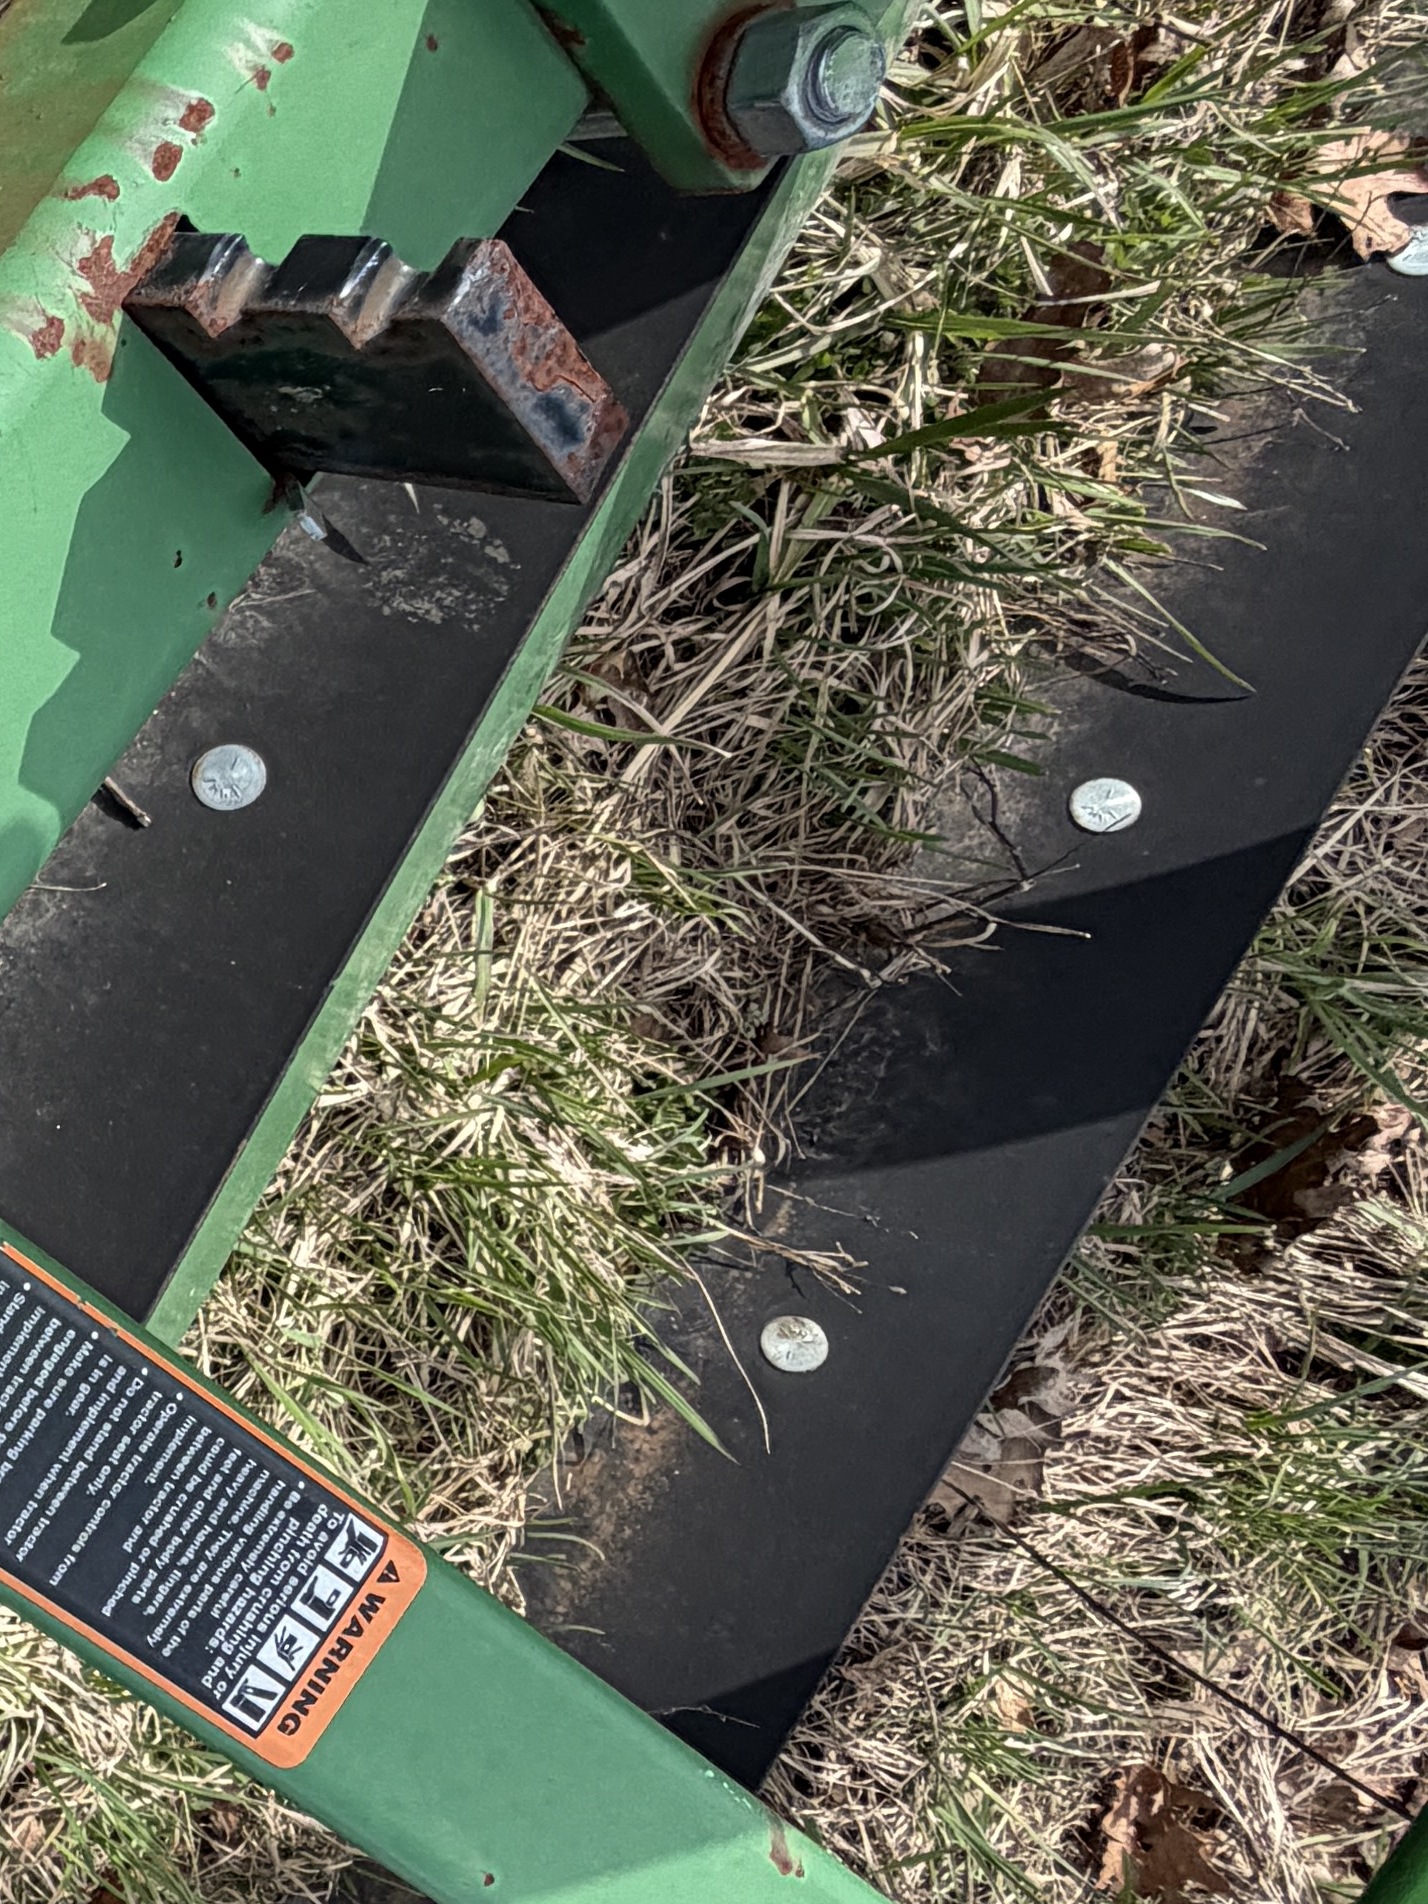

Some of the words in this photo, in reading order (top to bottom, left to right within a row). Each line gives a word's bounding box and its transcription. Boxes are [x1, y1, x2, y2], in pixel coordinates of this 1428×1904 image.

[18, 1317, 63, 1375] between
[33, 1329, 76, 1389] engaged
[63, 1340, 94, 1377] Make
[98, 1354, 114, 1368] is
[43, 1377, 68, 1409] sure
[87, 1368, 104, 1384] in
[105, 1365, 127, 1394] and
[125, 1376, 145, 1398] Do
[3, 1387, 40, 1432] before
[58, 1392, 111, 1463] implement
[108, 1397, 129, 1422] not
[129, 1390, 163, 1436] tractor
[138, 1402, 178, 1454] Operate
[6, 1407, 47, 1461] parking
[83, 1421, 113, 1462] stand
[107, 1434, 132, 1466] seat
[170, 1425, 213, 1481] between
[197, 1436, 226, 1476] could
[219, 1447, 242, 1474] feet
[33, 1463, 63, 1500] when
[44, 1460, 89, 1517] between
[109, 1454, 143, 1500] tractor
[184, 1474, 203, 1493] be
[202, 1473, 223, 1501] and
[225, 1458, 258, 1499] heavy
[141, 1481, 176, 1526] tractor
[148, 1492, 188, 1548] crushed
[179, 1500, 205, 1536] other
[208, 1497, 229, 1526] and
[242, 1479, 287, 1536] handling
[283, 1491, 301, 1510] Be
[326, 1511, 346, 1530] To
[4, 1500, 39, 1546] tractor
[15, 1516, 51, 1563] tractor
[71, 1498, 112, 1553] controls
[122, 1524, 143, 1554] and
[240, 1510, 286, 1573] extremely
[295, 1503, 329, 1548] death
[138, 1547, 151, 1564] or
[154, 1535, 183, 1570] body
[204, 1529, 234, 1562] They
[210, 1537, 248, 1584] various
[248, 1516, 301, 1592] pinching
[296, 1531, 329, 1577] avoid
[48, 1553, 77, 1587] from
[131, 1568, 159, 1604] parts
[189, 1560, 208, 1584] are
[269, 1548, 301, 1586] from
[101, 1561, 141, 1617] pinched
[187, 1583, 215, 1619] parts
[210, 1572, 244, 1619] careful
[256, 1575, 299, 1633] serious
[146, 1584, 193, 1648] extremely
[176, 1619, 190, 1637] of
[220, 1587, 273, 1656] crushing
[161, 1634, 182, 1658] the
[224, 1634, 263, 1680] injury
[276, 1592, 387, 1737] WARNING
[200, 1656, 227, 1689] and
[212, 1680, 228, 1701] or
